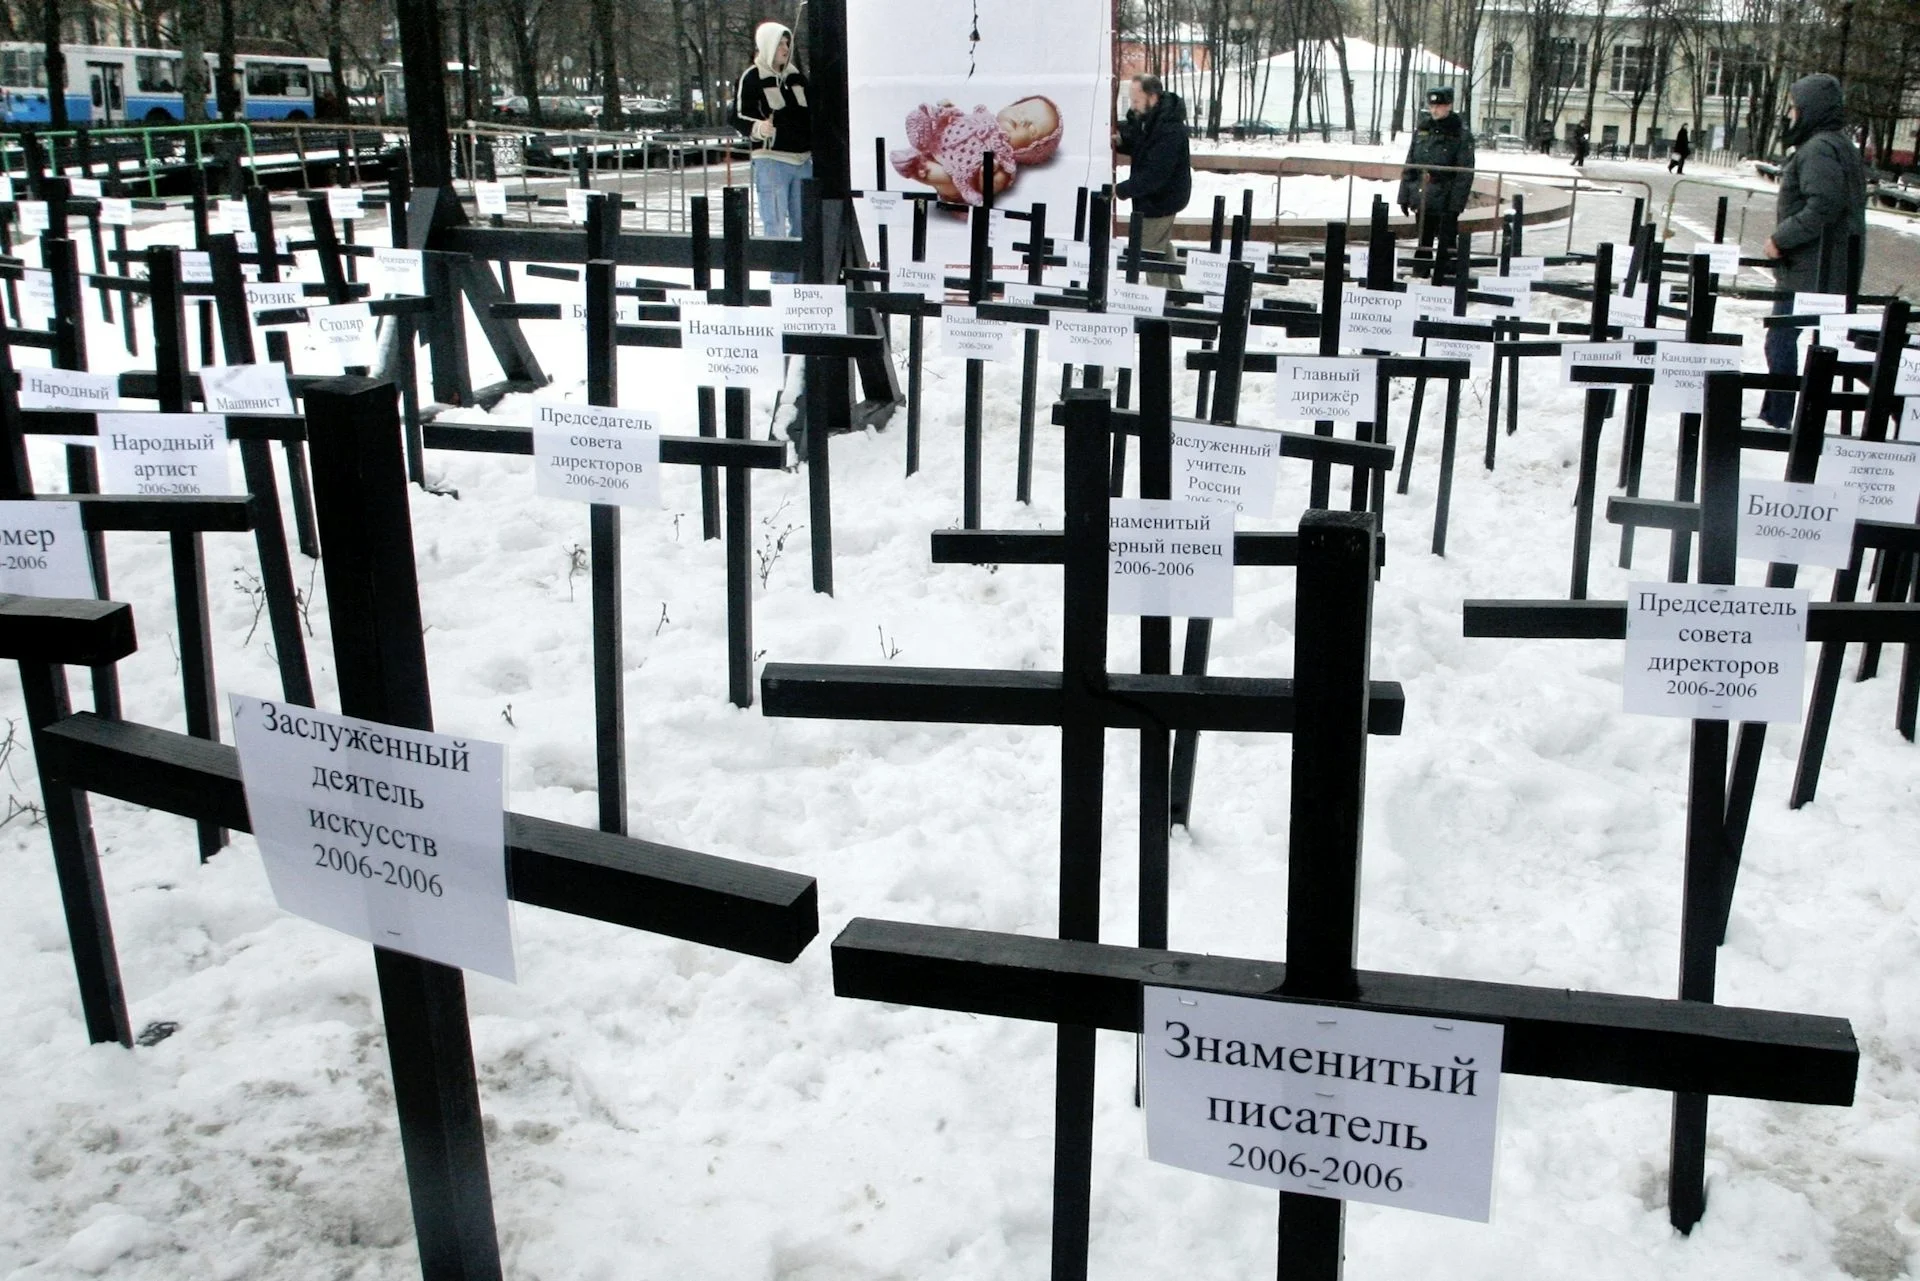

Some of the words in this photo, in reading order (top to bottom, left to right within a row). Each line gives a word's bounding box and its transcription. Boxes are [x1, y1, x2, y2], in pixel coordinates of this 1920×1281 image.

[897, 267, 937, 281] Лётчик
[246, 290, 297, 305] Физик
[793, 288, 823, 301] Врач,
[1113, 288, 1150, 301] Учитель
[1343, 291, 1402, 309] Директор
[1414, 292, 1453, 305] Ткачиха
[785, 306, 834, 318] директор
[1350, 312, 1392, 323] школы
[319, 318, 365, 333] Столяр
[688, 319, 775, 338] Начальник
[784, 322, 837, 333] института
[1055, 319, 1129, 335] Реставратор
[1348, 325, 1392, 335] 2006-2006
[950, 329, 1003, 341] композитор
[1070, 336, 1113, 346] 2006-2006
[706, 344, 758, 360] отдела
[1573, 351, 1623, 362] Главный
[1661, 352, 1707, 364] Кандидат
[708, 363, 759, 375] 2006-2006
[1292, 367, 1360, 383] Главный
[31, 379, 110, 400] Народный
[217, 397, 280, 411] Машинист
[1291, 388, 1359, 411] дирижёр
[540, 407, 652, 431] Председатель
[1300, 406, 1350, 417] 2006-2006
[111, 433, 215, 455] Народный
[570, 434, 622, 450] совета
[1170, 432, 1271, 457] Заслуженный
[1834, 445, 1917, 463] Заслуженный
[134, 464, 198, 477] артист
[551, 455, 643, 474] директоров
[1185, 458, 1246, 476] учитель
[1849, 466, 1895, 476] деятель
[138, 483, 201, 494] 2006-2006
[565, 474, 629, 490] 2006-2006
[1188, 476, 1241, 496] России
[1747, 494, 1839, 522] Биолог
[1858, 495, 1894, 506] 6-2006
[1109, 515, 1210, 531] наменитый
[1755, 525, 1821, 541] 2006-2006
[1109, 539, 1165, 557] ерный
[1171, 542, 1223, 557] певец
[1114, 561, 1195, 577] 2006-2006
[1638, 592, 1797, 617] Председатель
[1678, 627, 1752, 644] совета
[1647, 655, 1779, 678] директоров
[1666, 680, 1758, 698] 2006-2006
[260, 702, 471, 773] Заслуженный
[312, 766, 425, 811] деятель
[308, 808, 438, 858] искусств
[313, 843, 444, 898] 2006-2006
[1164, 1020, 1479, 1097] Знаменитый
[1206, 1096, 1429, 1152] писатель
[1227, 1143, 1404, 1193] 2006-2006
